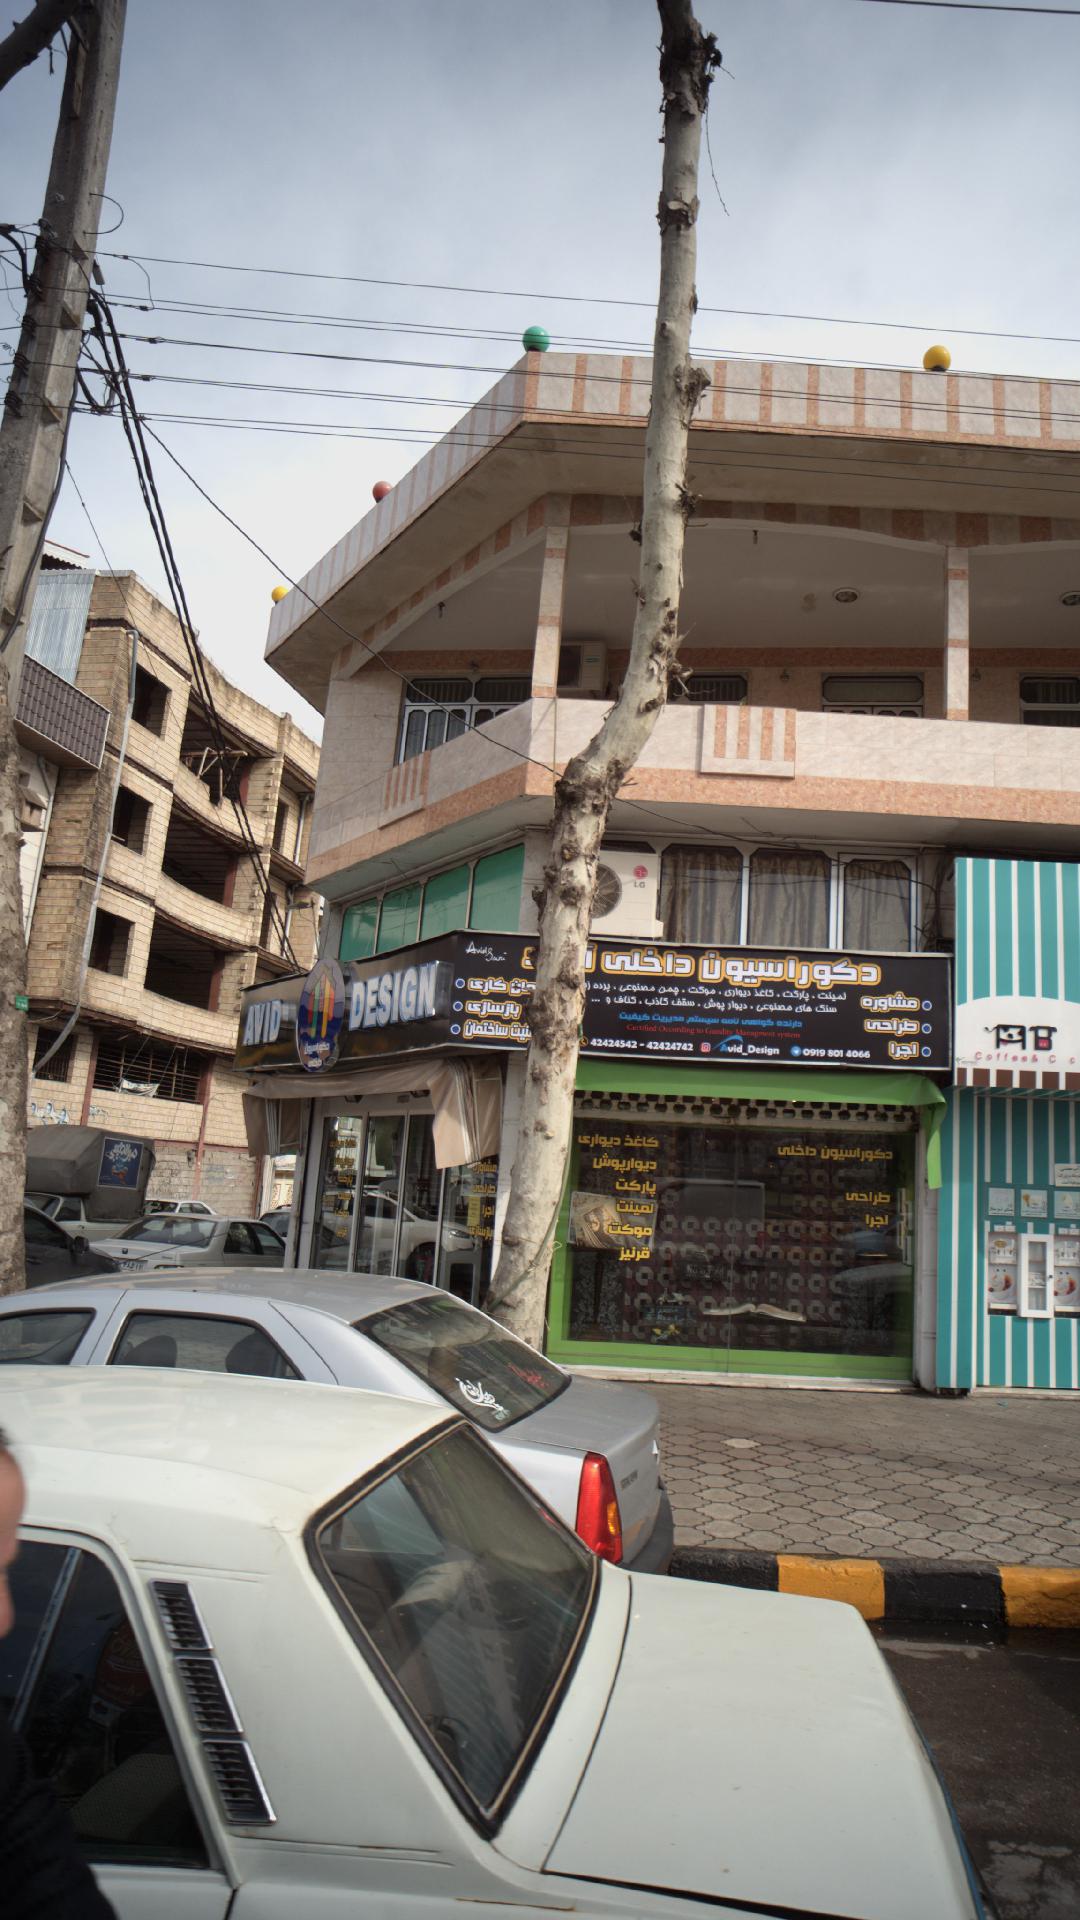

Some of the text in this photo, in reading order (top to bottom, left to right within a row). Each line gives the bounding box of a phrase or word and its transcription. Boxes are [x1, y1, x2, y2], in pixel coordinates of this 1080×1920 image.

[633, 881, 646, 889] LG
[602, 949, 694, 975] داخلی
[700, 952, 880, 988] دکوراسیون
[469, 978, 508, 994] کاری
[619, 982, 656, 994] مصنوعی
[658, 985, 680, 997] چمن
[688, 984, 717, 995] موکت
[724, 986, 751, 998] دیواری
[754, 987, 775, 998] کاغذ
[349, 960, 440, 1032] DESIGN
[645, 996, 668, 1007] کاذب
[670, 997, 696, 1007] سقف
[783, 990, 811, 1001] پارکت
[817, 992, 847, 1002] لمینت
[862, 992, 920, 1012] مشاوره
[467, 1000, 521, 1019] بازسازی
[704, 998, 725, 1011] پوش
[756, 1001, 793, 1013] مصنوعی
[243, 1000, 283, 1047] AVID
[464, 1020, 510, 1039] ساختمان
[864, 1018, 920, 1036] طراحی
[803, 1048, 827, 1057] 0919
[829, 1048, 844, 1058] 801
[846, 1049, 871, 1059] 4066
[889, 1042, 919, 1059] اجرا
[578, 1134, 659, 1148] کاغذ دیواری
[777, 1144, 894, 1162] دکوراسیون داخلی
[592, 1153, 657, 1173] دیوارپوش
[615, 1178, 657, 1197] پارکت
[846, 1191, 891, 1206] طراحی
[616, 1200, 654, 1216] لمینت
[608, 1222, 653, 1239] موکت
